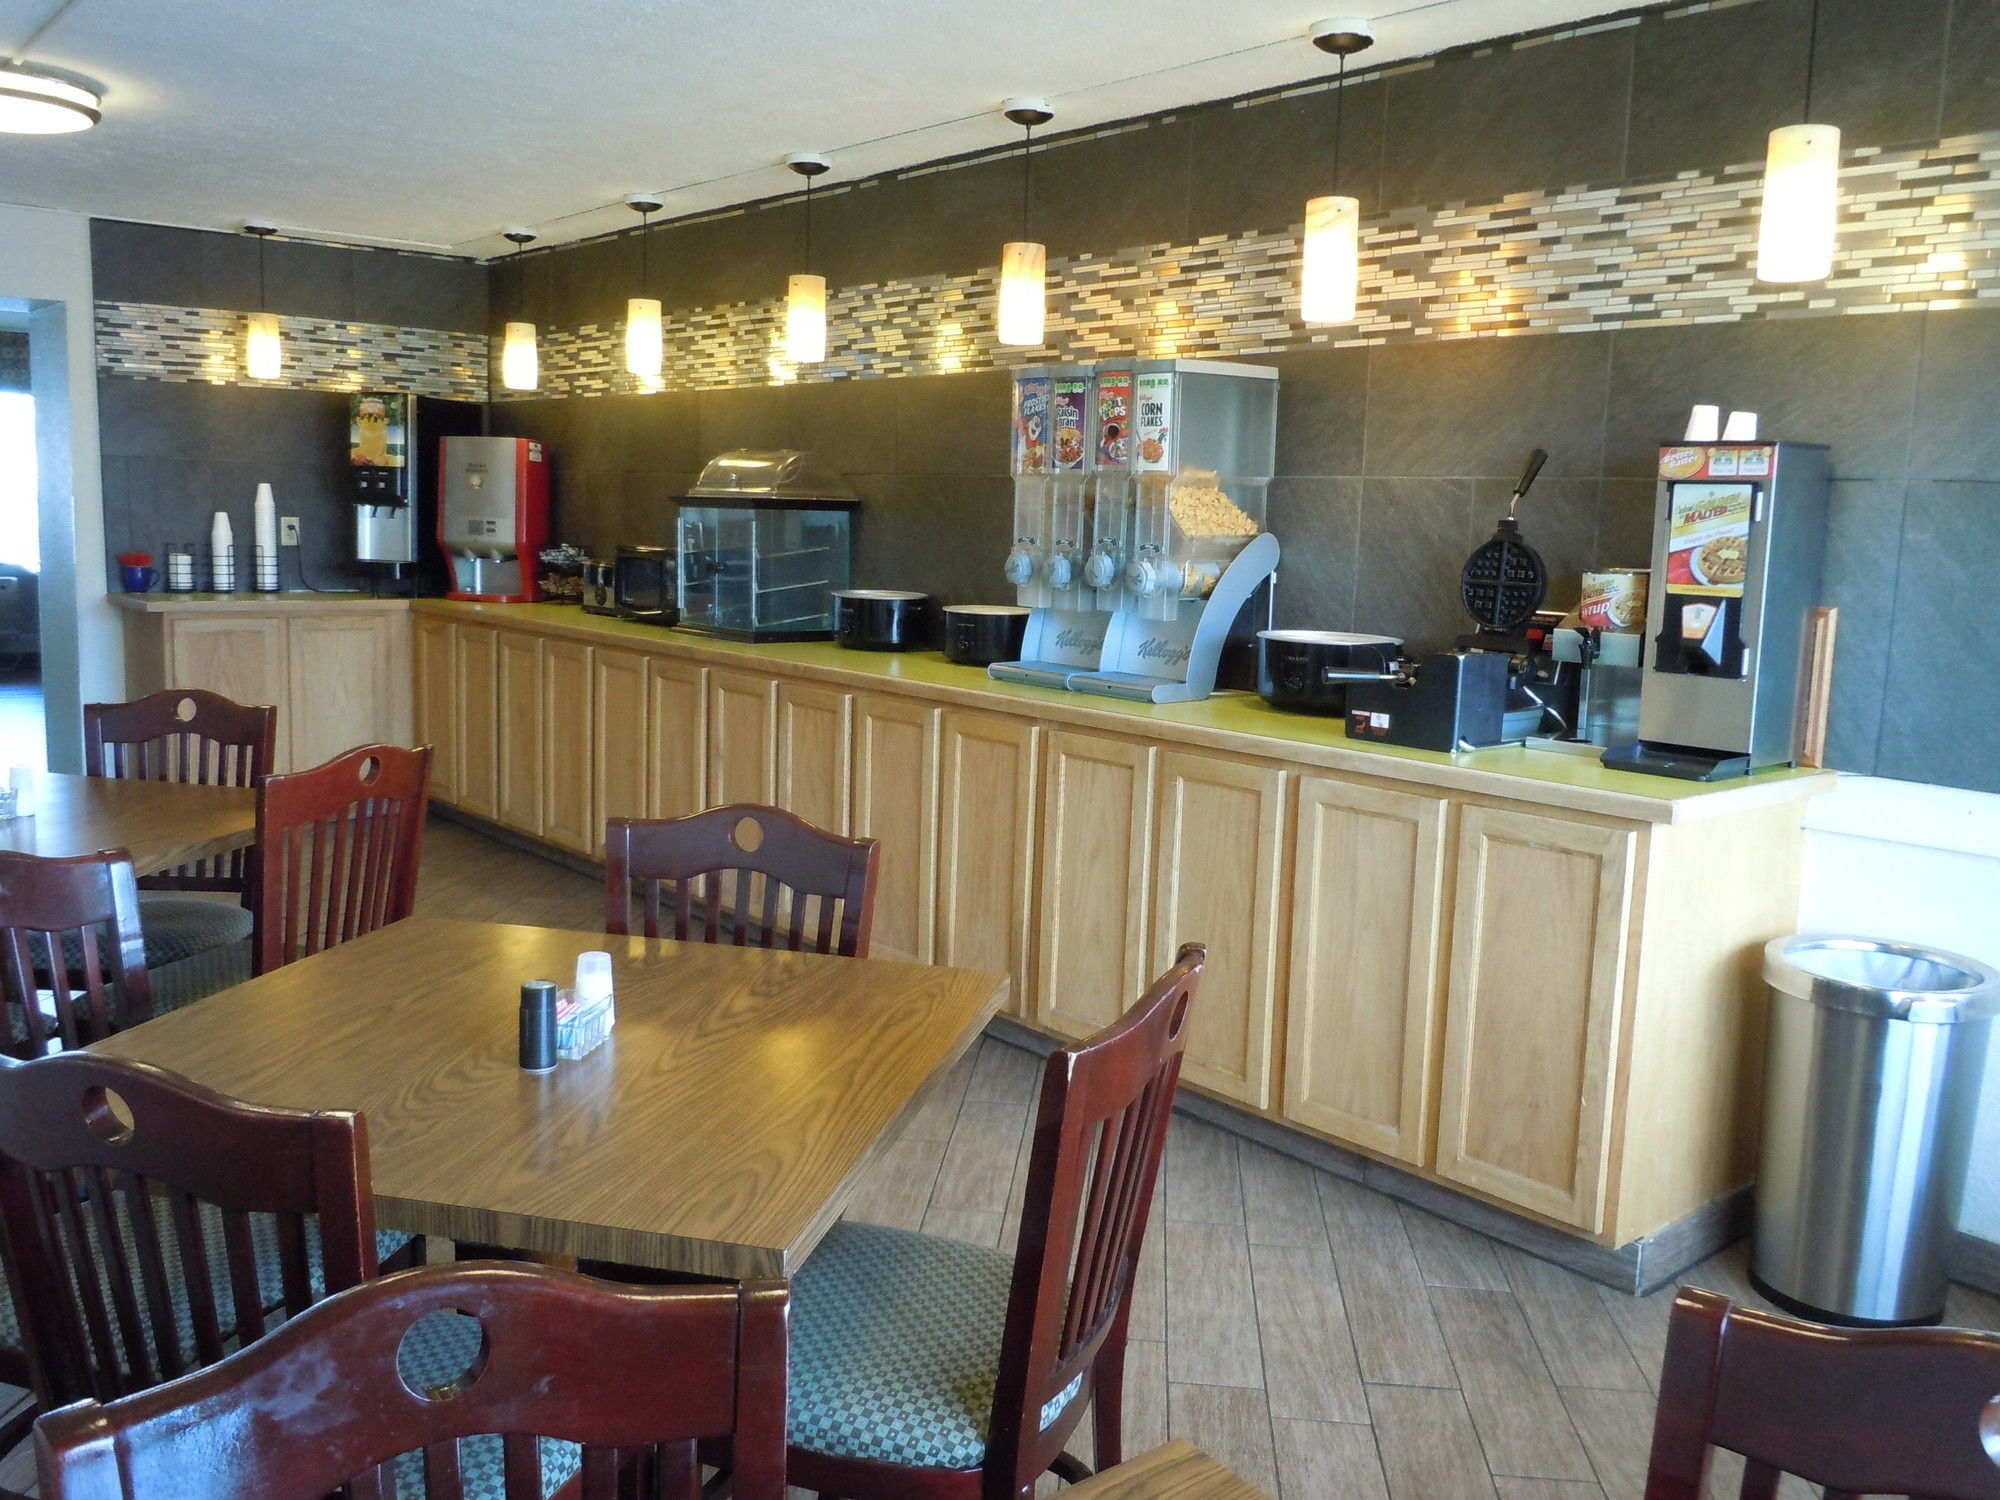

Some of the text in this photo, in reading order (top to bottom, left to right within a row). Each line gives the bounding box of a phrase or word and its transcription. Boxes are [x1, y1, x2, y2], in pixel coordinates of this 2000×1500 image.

[1141, 403, 1163, 416] CORN
[1058, 417, 1076, 428] Bran
[1141, 416, 1163, 427] FLAKES
[1683, 505, 1728, 524] MALTED
